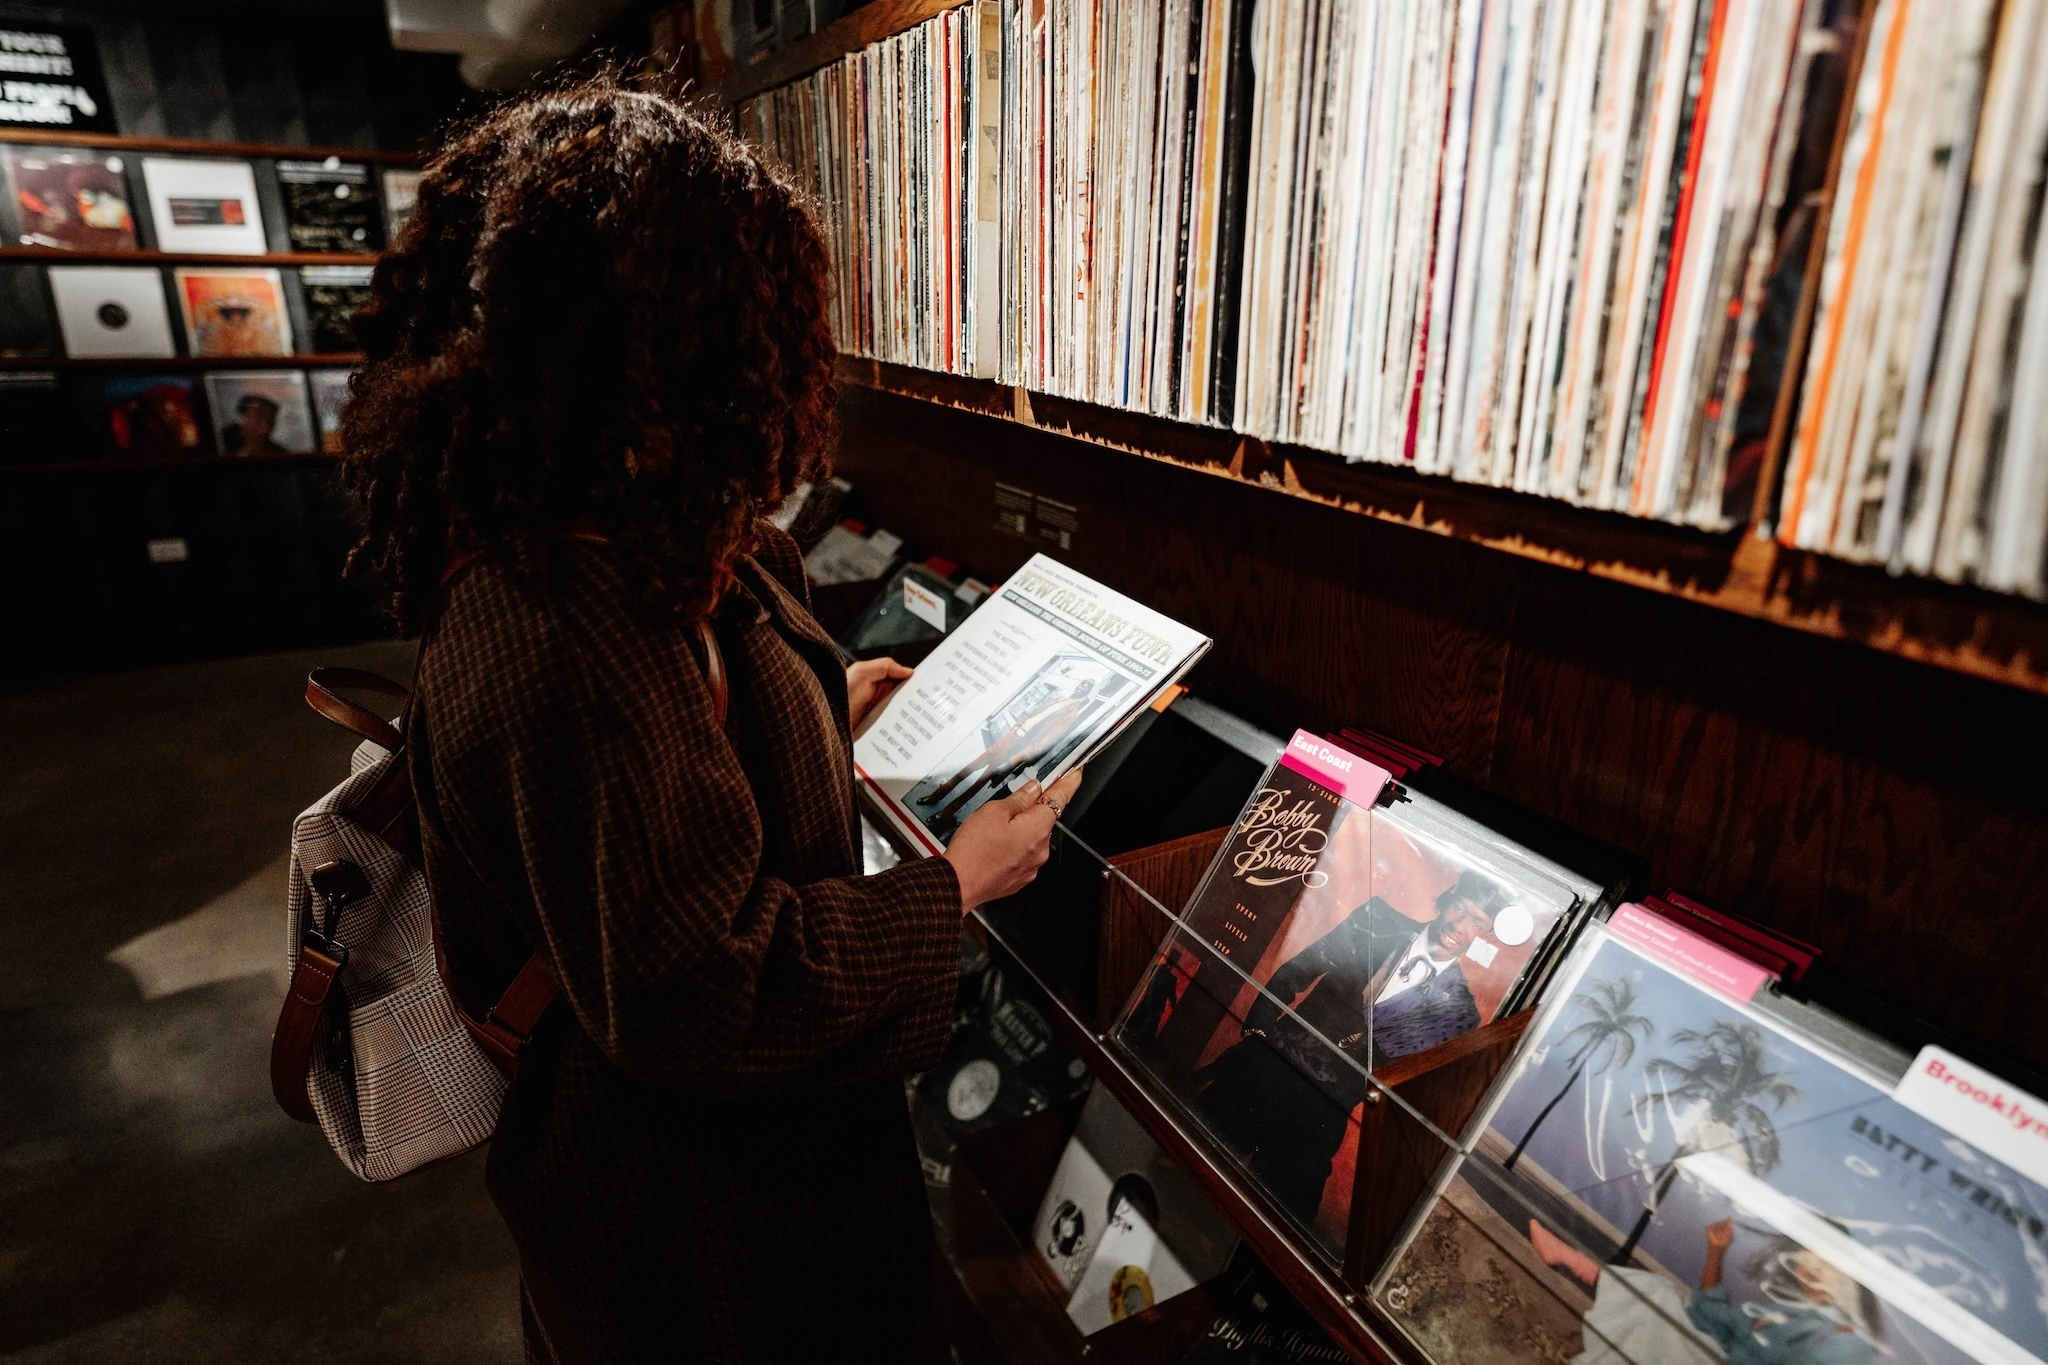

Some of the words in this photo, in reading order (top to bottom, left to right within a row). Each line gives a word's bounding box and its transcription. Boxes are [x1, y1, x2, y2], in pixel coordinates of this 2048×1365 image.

[1013, 568, 1059, 600] NEW
[1048, 586, 1130, 639] ORLEANS
[1118, 624, 1175, 666] FUNK
[961, 640, 988, 661] PROFESSOR
[1051, 617, 1080, 637] ORIGINAL
[1077, 632, 1101, 648] SOUND
[1097, 644, 1110, 653] OF
[1106, 649, 1128, 664] FUNK
[1125, 659, 1152, 677] 1960-75
[897, 708, 908, 719] THE
[919, 709, 944, 732] TOUSSAINT
[878, 727, 889, 738] AND
[886, 735, 900, 749] MANY
[892, 722, 903, 732] THE
[1293, 735, 1320, 757] East
[1318, 747, 1353, 773] Coast
[1319, 790, 1346, 809] SINGLE
[1237, 788, 1328, 853] Bobby
[1233, 827, 1328, 888] Brown
[1236, 902, 1258, 921] EVERY
[1225, 921, 1248, 942] LITTLE
[1213, 939, 1231, 955] STEP
[1207, 1317, 1275, 1351] Phyllis
[1282, 1329, 1350, 1362] Hyman
